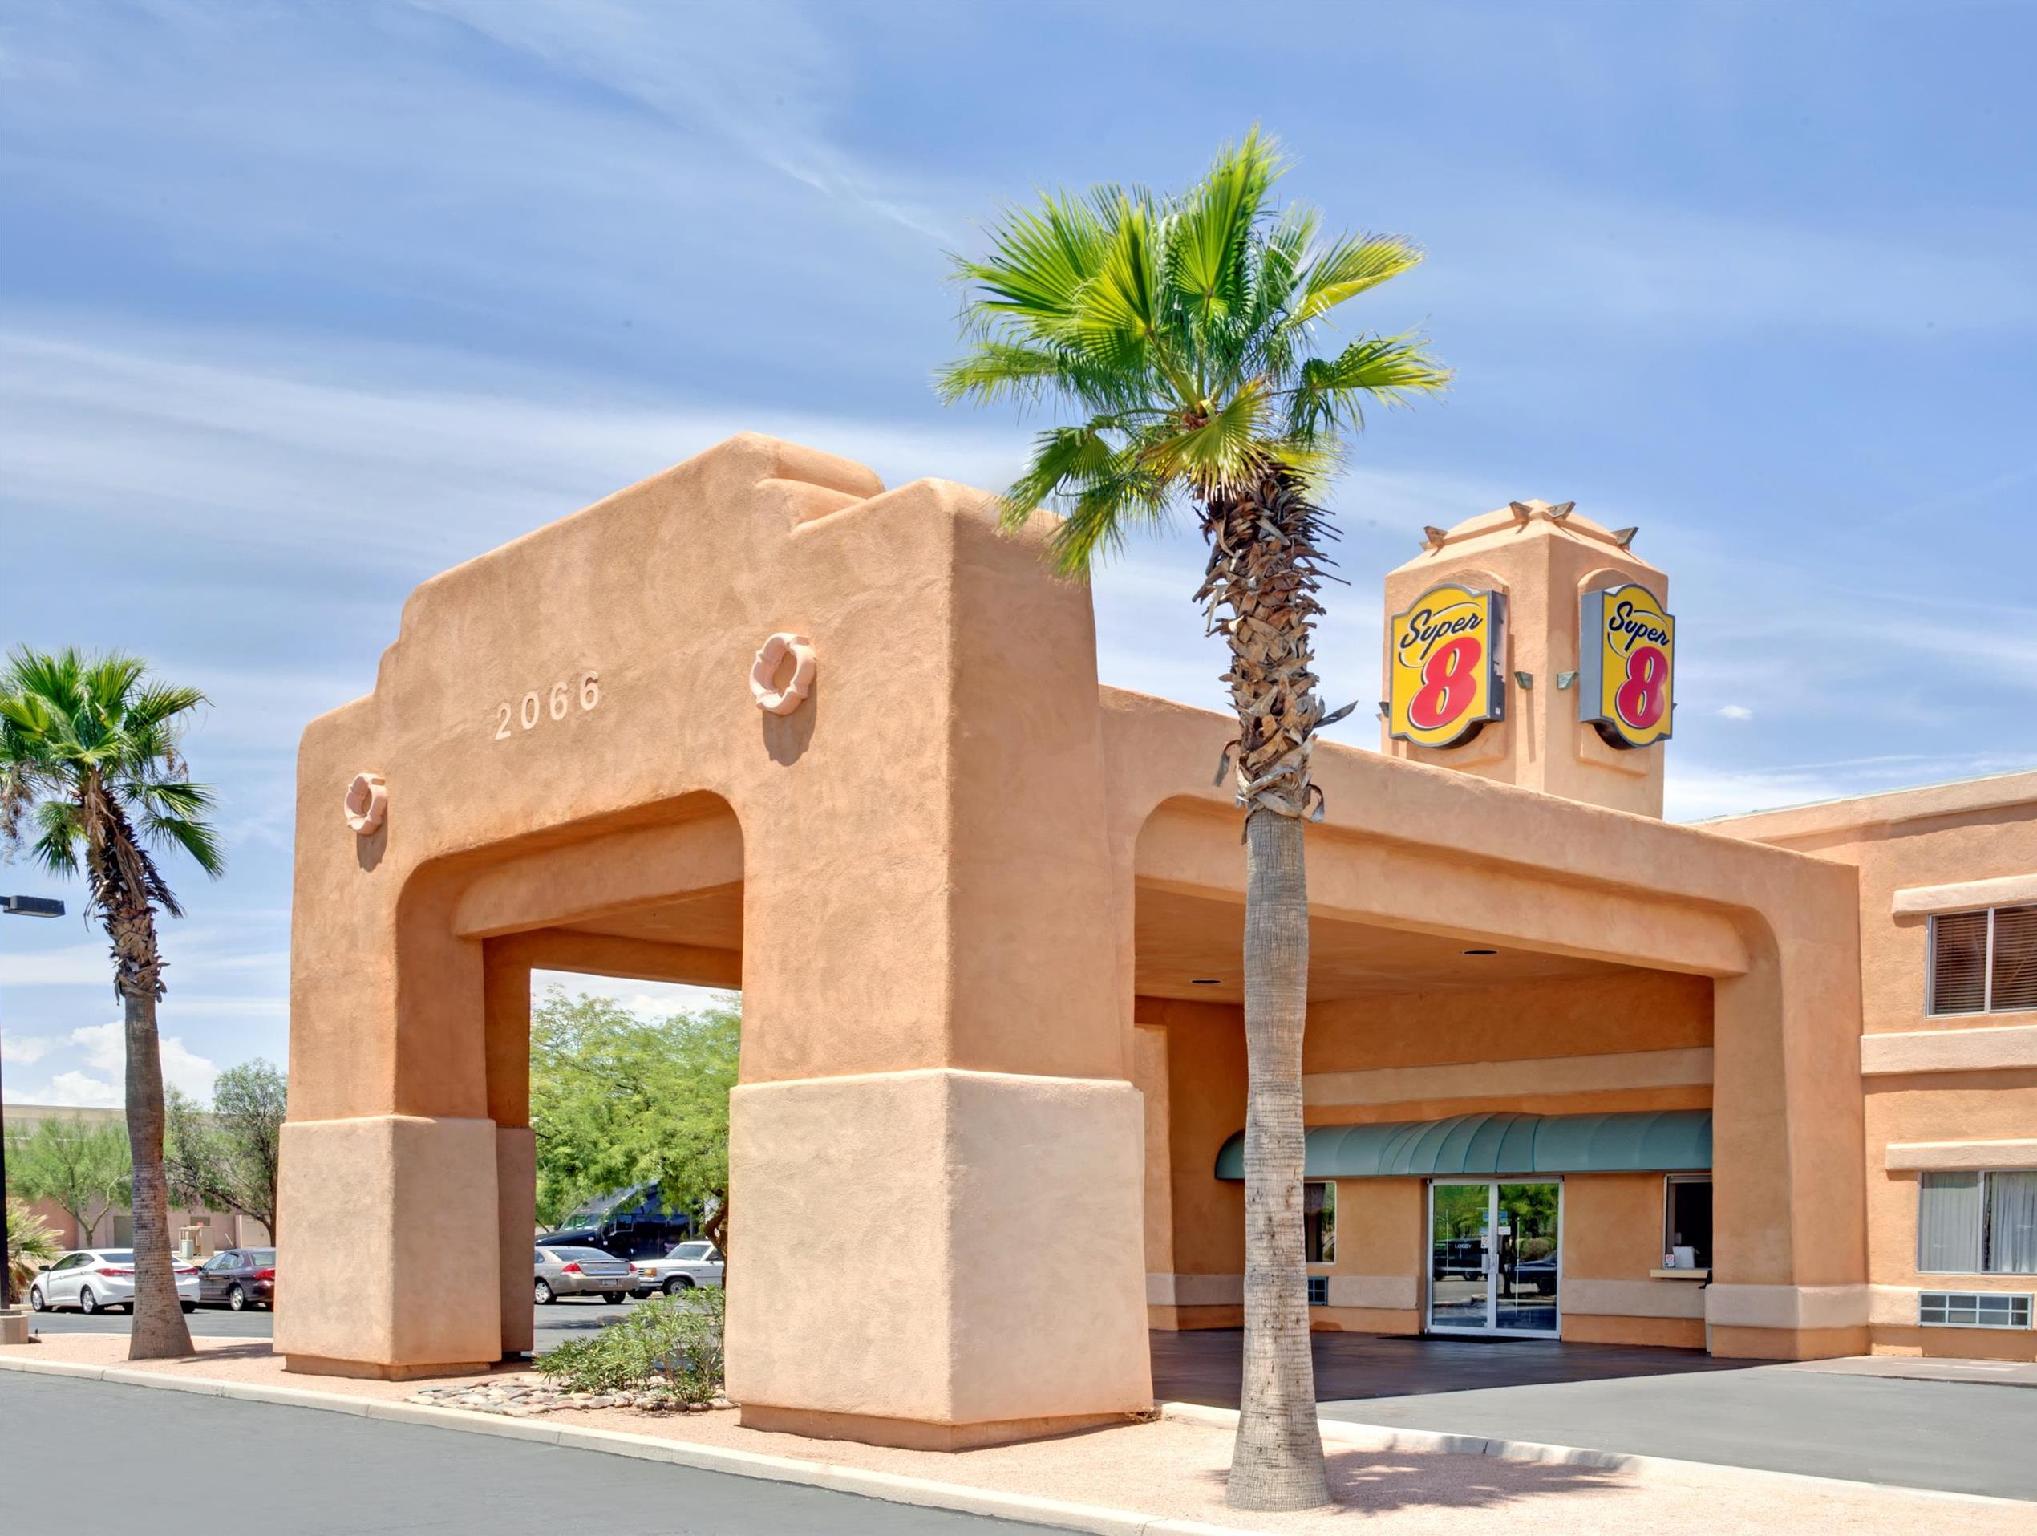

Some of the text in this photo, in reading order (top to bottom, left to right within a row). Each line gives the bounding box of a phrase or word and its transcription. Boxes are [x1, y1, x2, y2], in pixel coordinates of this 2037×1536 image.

[1400, 609, 1483, 660] Super
[1609, 601, 1670, 651] Super
[495, 670, 599, 740] 2066
[1407, 637, 1481, 731] 8
[1615, 646, 1668, 730] 8
